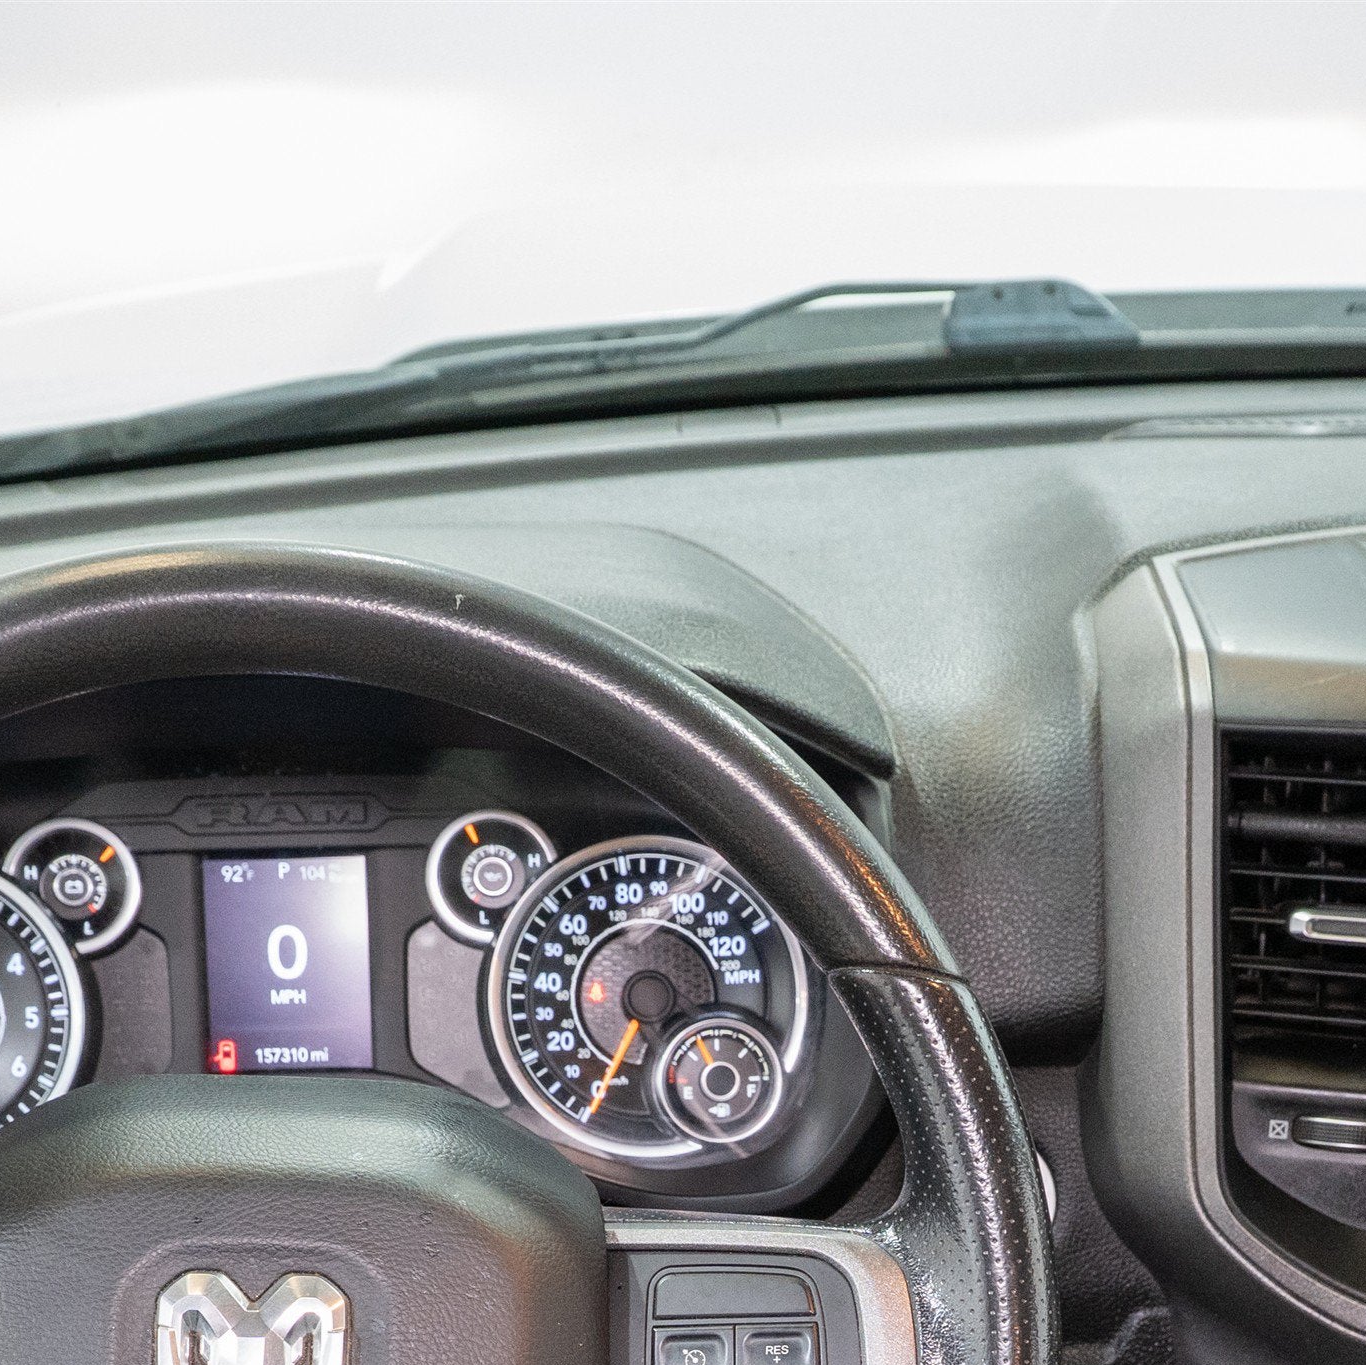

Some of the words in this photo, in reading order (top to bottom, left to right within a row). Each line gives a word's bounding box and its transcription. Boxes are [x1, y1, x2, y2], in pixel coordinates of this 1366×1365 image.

[527, 853, 541, 868] H
[24, 865, 39, 881] H
[278, 862, 290, 879] P
[615, 882, 643, 904] 80
[649, 881, 668, 896] 90
[587, 895, 607, 911] 70
[668, 892, 705, 914] 100
[479, 910, 490, 925] L
[559, 914, 587, 935] 60
[705, 910, 729, 926] 110
[83, 921, 94, 936] L
[267, 924, 308, 980] 0
[544, 943, 563, 958] 50
[708, 935, 746, 957] 120
[7, 953, 25, 977] 4
[534, 972, 562, 993] 40
[724, 969, 761, 985] MPH
[270, 989, 307, 1005] MPH
[25, 1006, 39, 1029] 5
[535, 1007, 554, 1021] 30
[546, 1031, 575, 1051] 20
[255, 1047, 309, 1063] 157310
[310, 1047, 329, 1062] mi
[11, 1055, 27, 1077] 6
[564, 1064, 580, 1079] 10
[683, 1086, 694, 1100] E
[746, 1083, 757, 1098] F
[765, 1345, 789, 1355] RES
